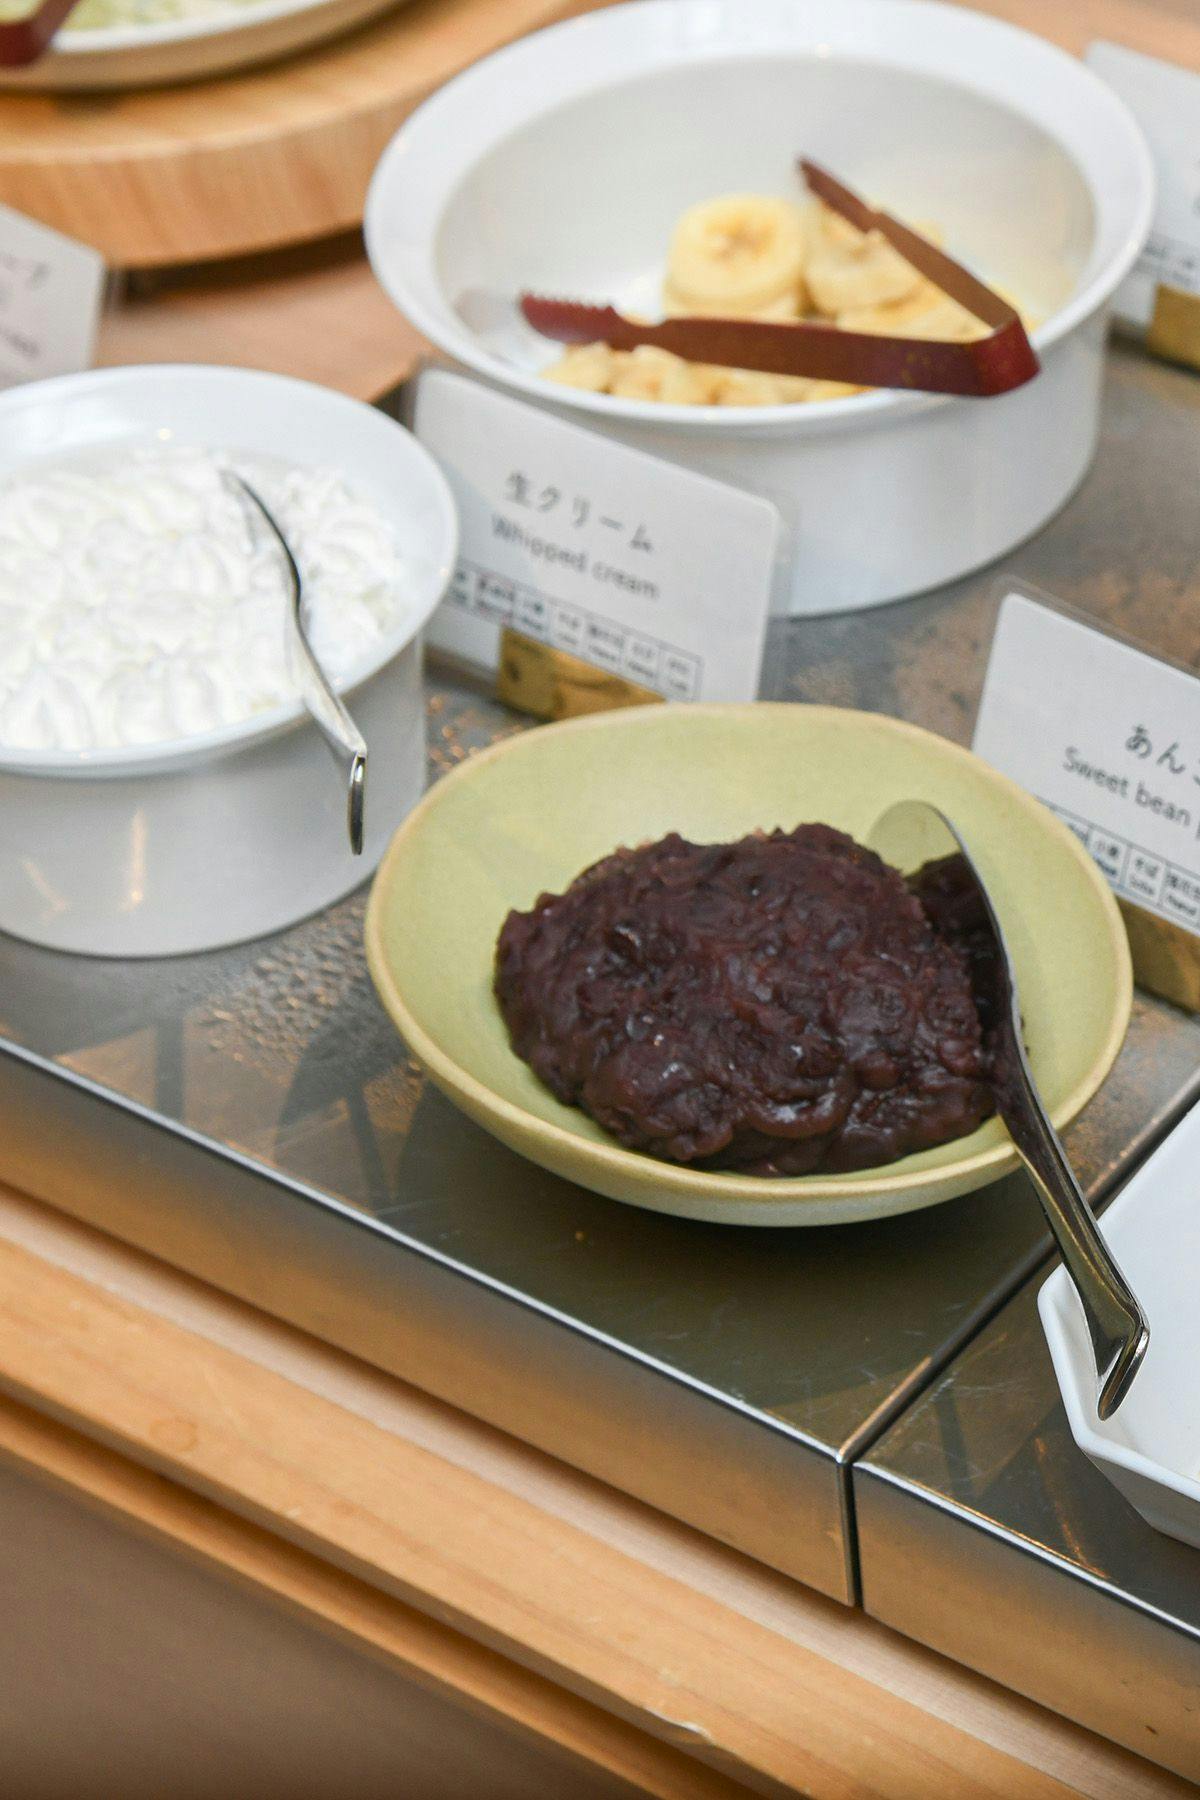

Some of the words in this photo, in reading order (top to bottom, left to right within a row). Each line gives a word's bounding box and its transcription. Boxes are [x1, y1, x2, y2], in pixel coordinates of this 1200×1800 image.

[506, 470, 654, 552] 生クリーム
[491, 513, 587, 573] Whipped
[592, 561, 660, 599] cream
[1062, 746, 1128, 798] Sweet
[1134, 781, 1191, 827] bean
